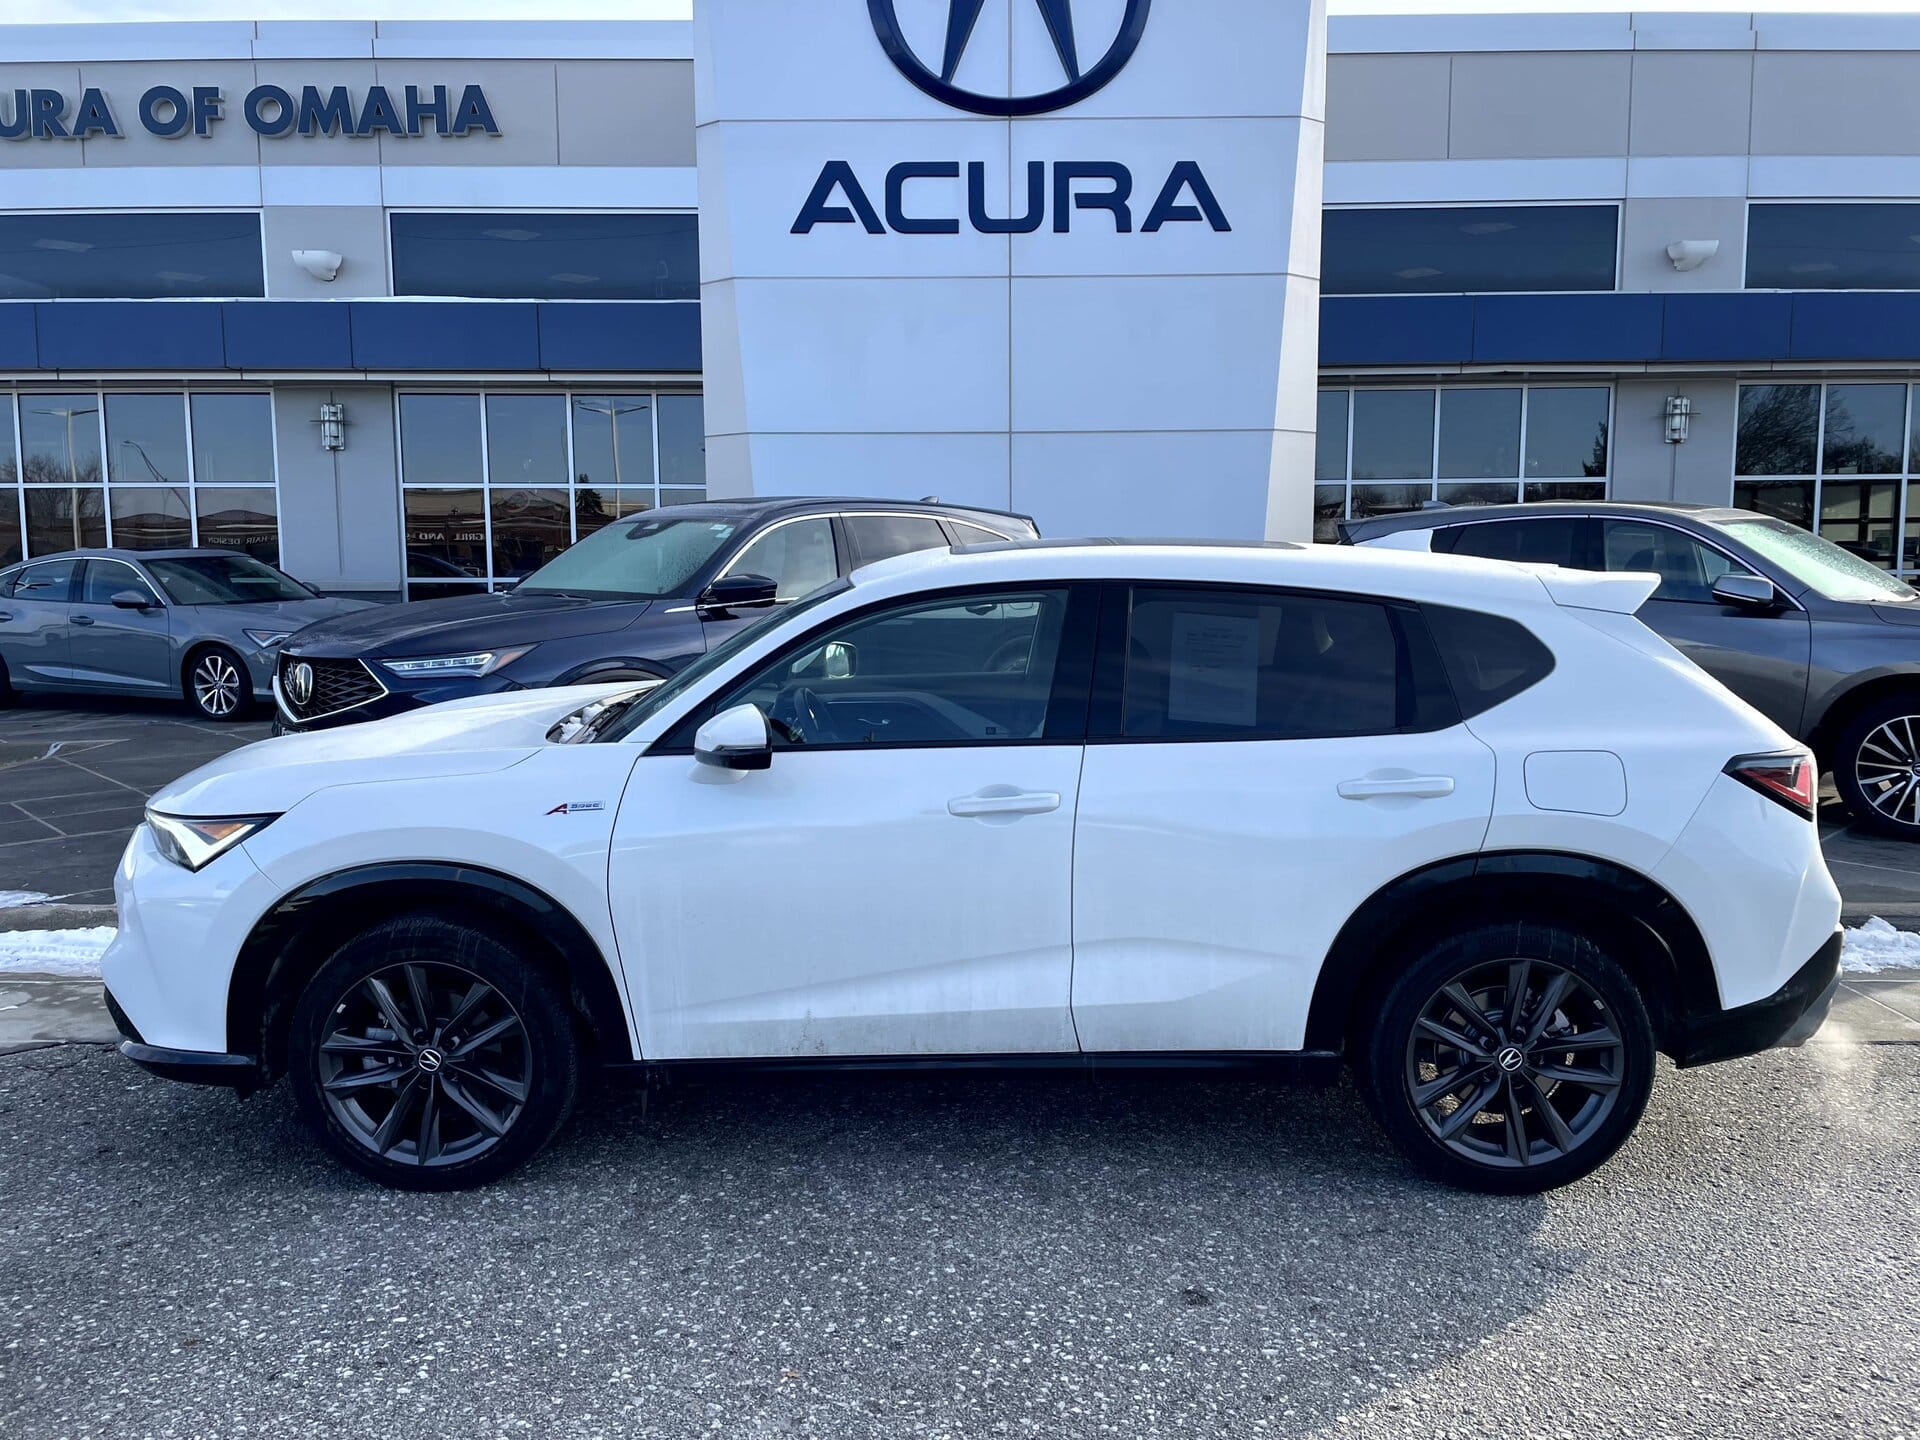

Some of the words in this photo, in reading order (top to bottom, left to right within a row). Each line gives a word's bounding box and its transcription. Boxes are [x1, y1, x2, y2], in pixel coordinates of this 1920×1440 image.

[138, 85, 224, 137] OF
[244, 84, 501, 136] OMAHA
[790, 160, 1232, 234] ACURA
